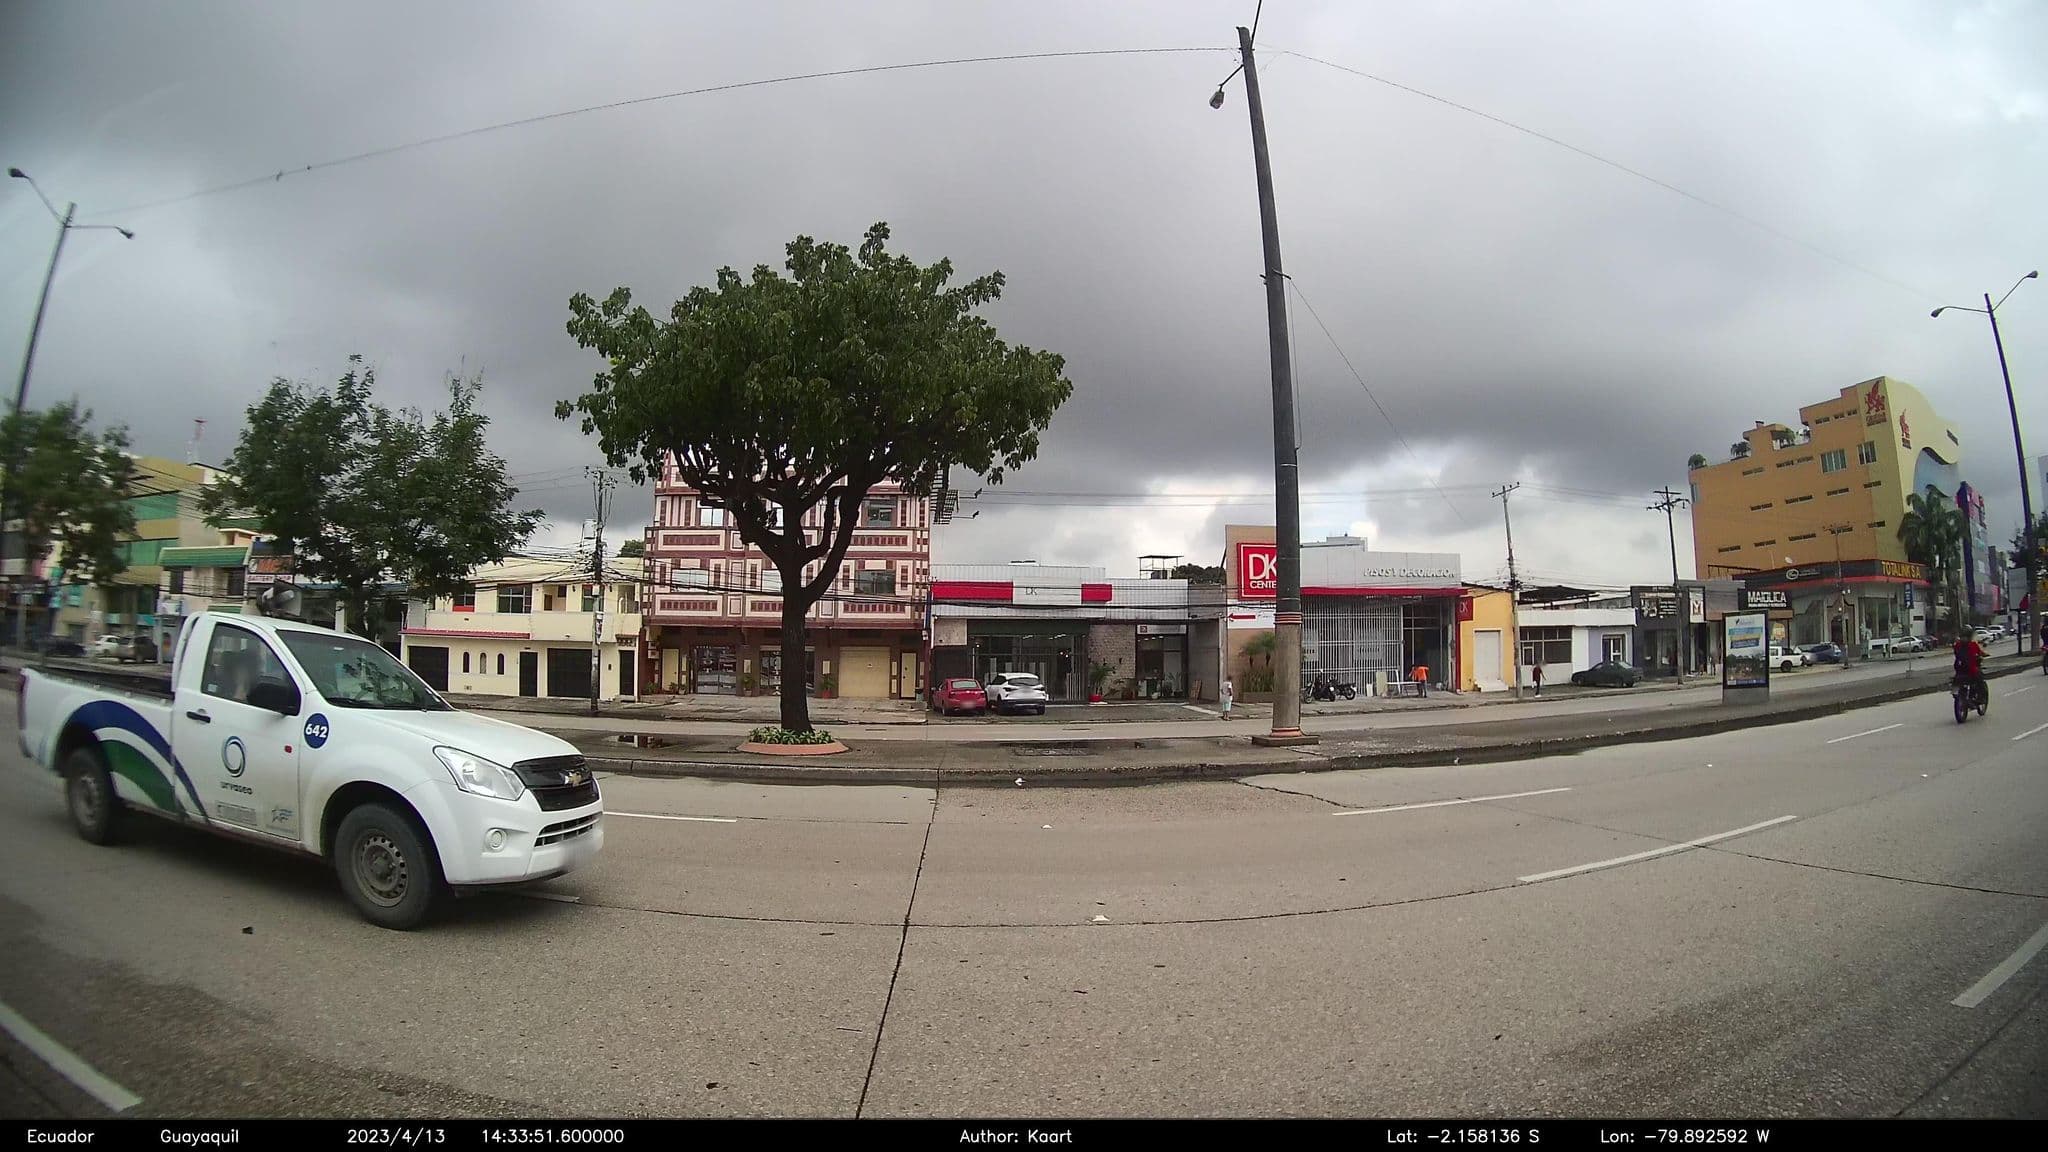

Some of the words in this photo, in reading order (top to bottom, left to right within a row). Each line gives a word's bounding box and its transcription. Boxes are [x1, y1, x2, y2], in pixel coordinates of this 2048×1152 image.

[1248, 553, 1277, 580] DK
[1364, 567, 1391, 577] PISOS
[1249, 580, 1277, 589] CENTE
[305, 723, 328, 738] 642
